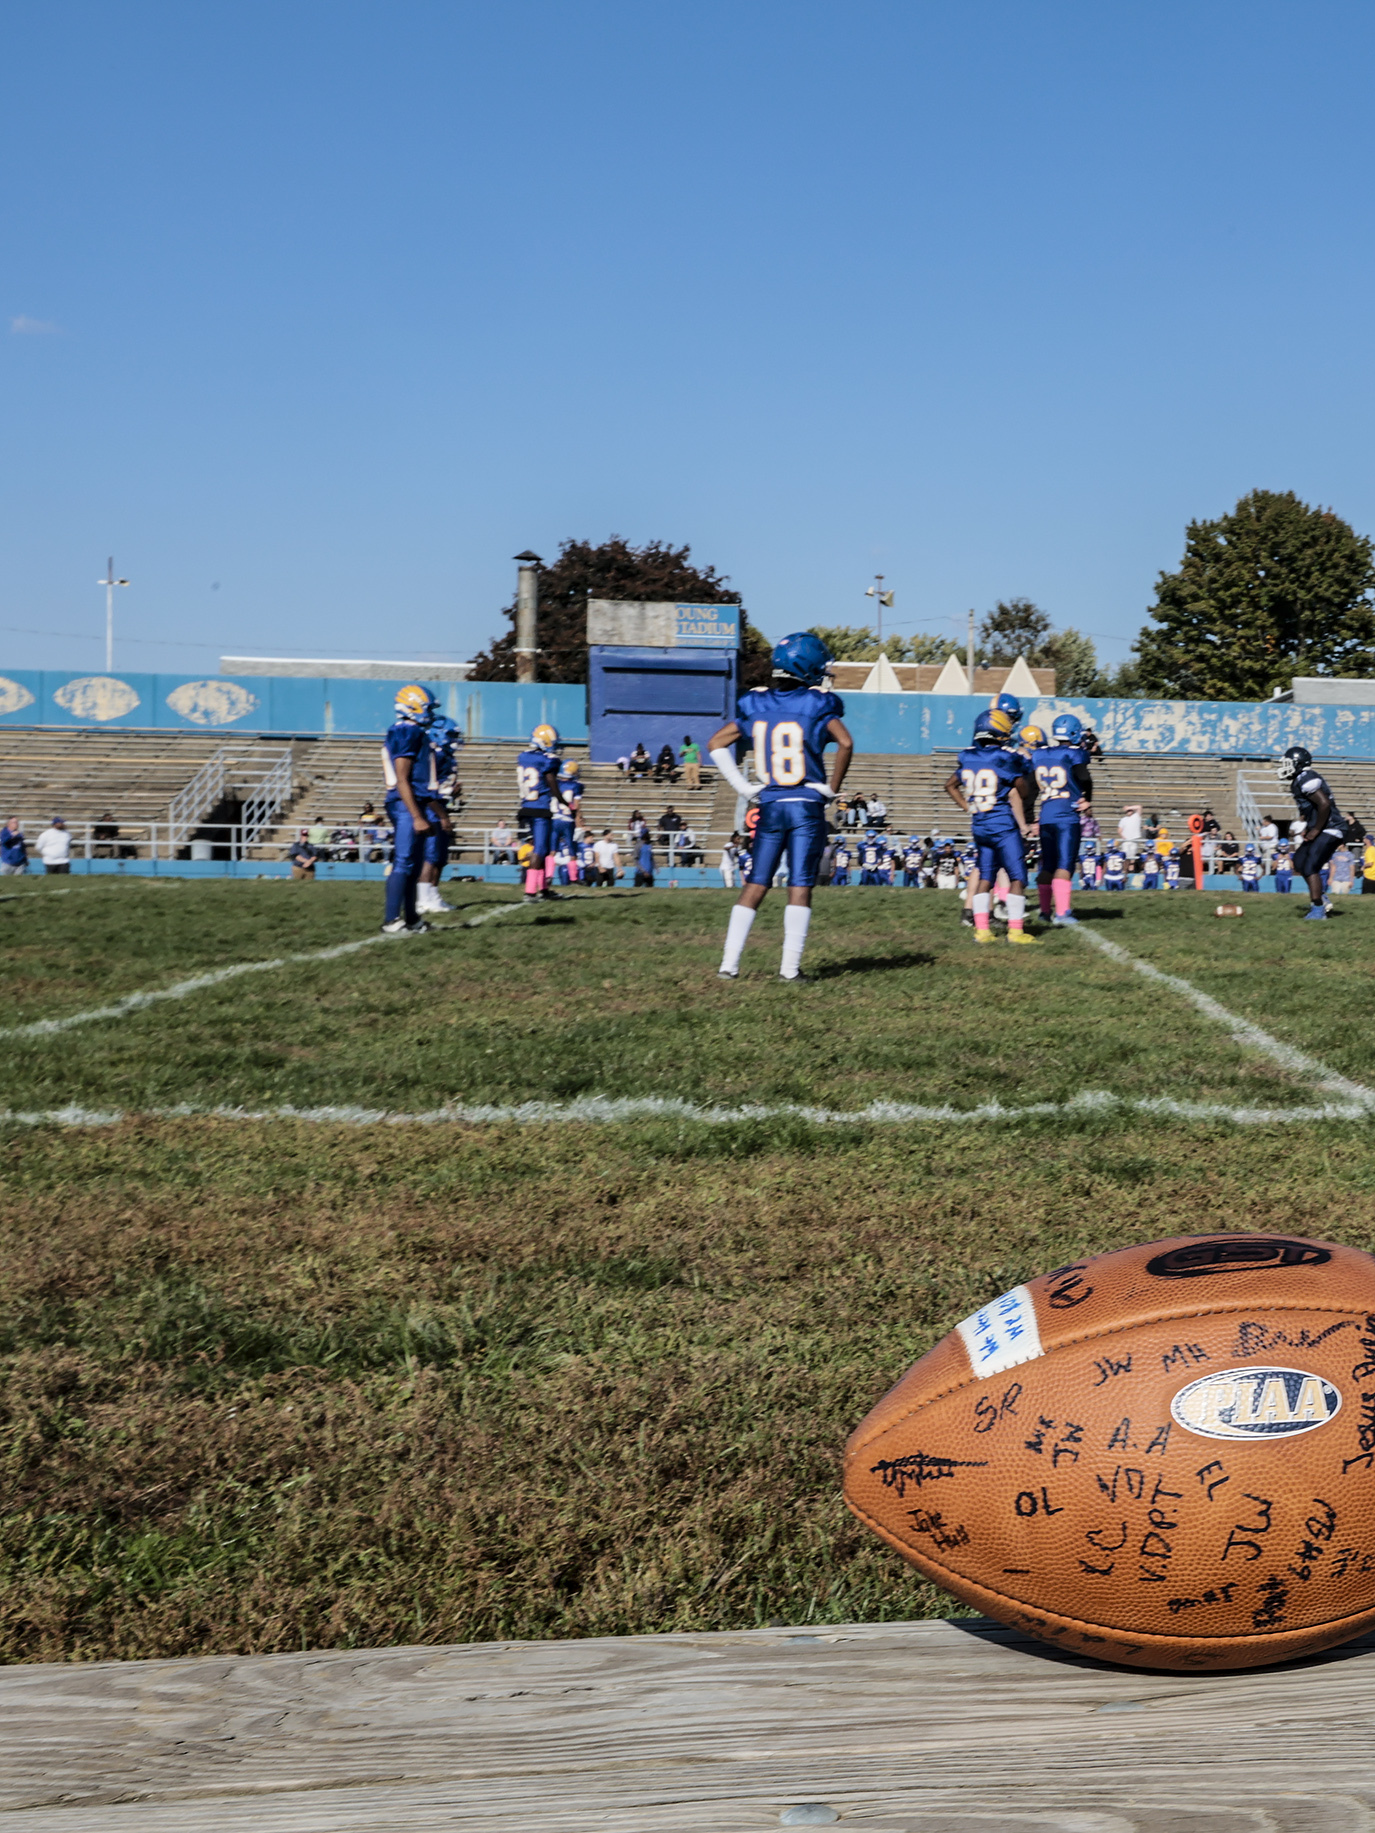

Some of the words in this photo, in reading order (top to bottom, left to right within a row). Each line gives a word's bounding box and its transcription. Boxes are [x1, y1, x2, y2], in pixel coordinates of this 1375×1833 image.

[675, 621, 736, 635] TADIUM
[752, 720, 807, 786] 18
[1093, 1353, 1132, 1386] JW
[1196, 1377, 1330, 1427] PIAA
[1015, 1487, 1064, 1517] OL
